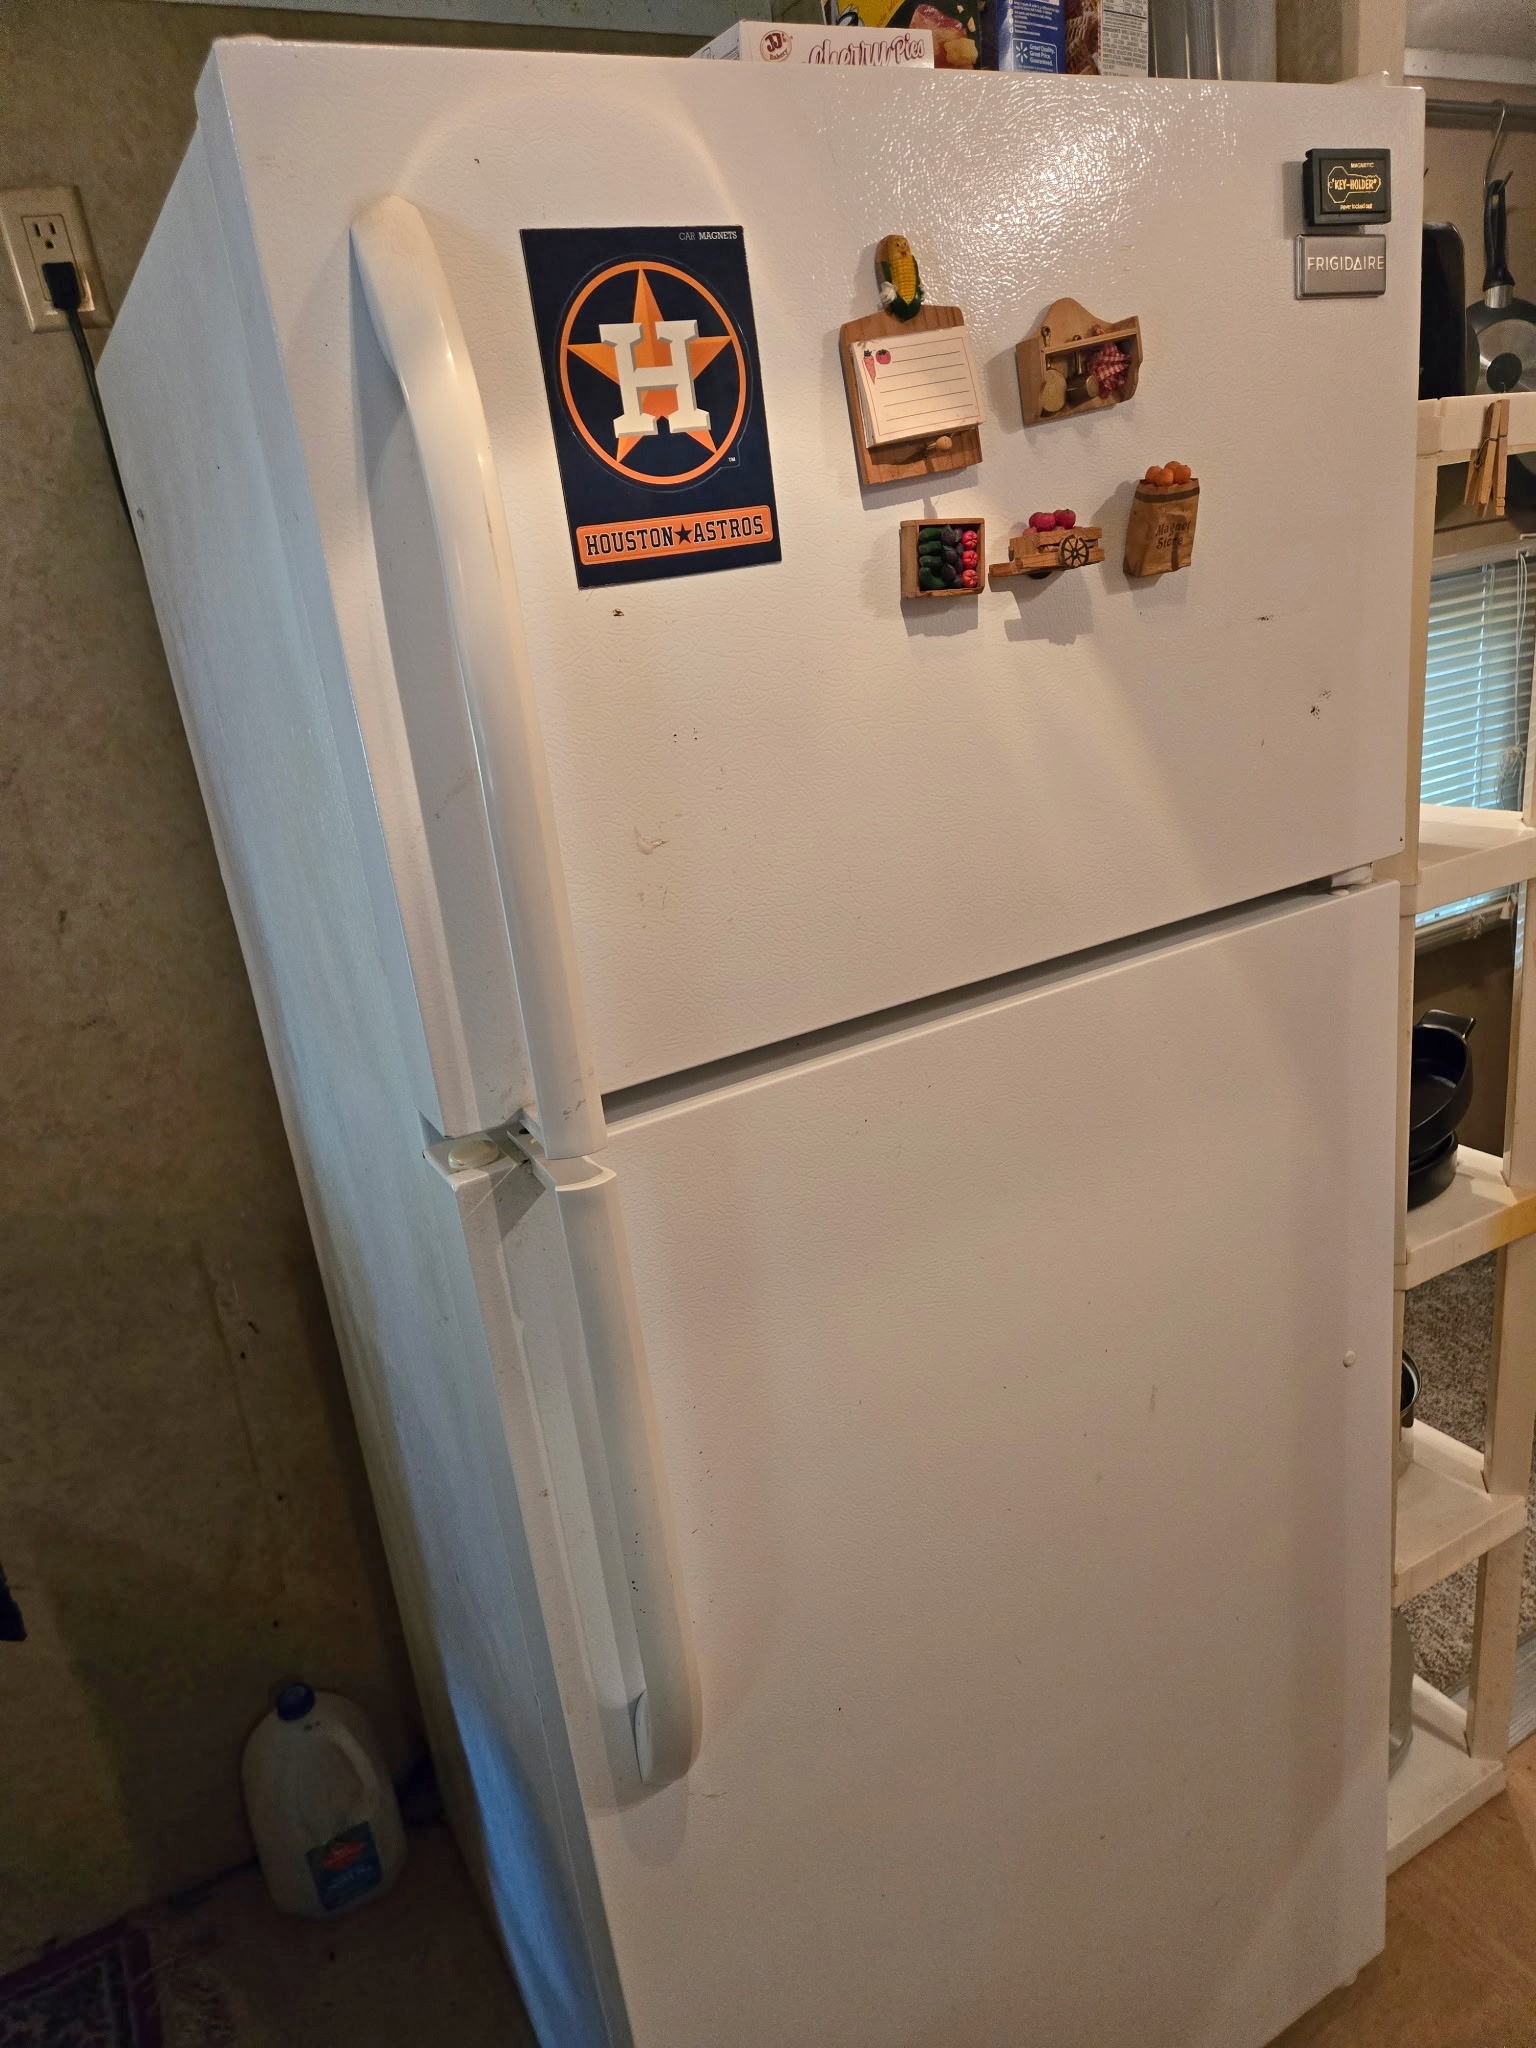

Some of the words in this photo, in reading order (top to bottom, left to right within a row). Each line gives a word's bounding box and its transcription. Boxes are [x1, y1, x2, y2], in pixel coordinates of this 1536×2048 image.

[890, 33, 925, 64] Pies
[679, 232, 696, 240] CAR
[698, 231, 738, 240] MAGNETS
[1307, 255, 1385, 271] FRIGIDAIRE
[598, 319, 711, 438] H
[584, 525, 675, 556] HOUSTON
[693, 514, 764, 543] ASTROS
[1156, 520, 1191, 537] Magnet
[1156, 536, 1183, 550] Store
